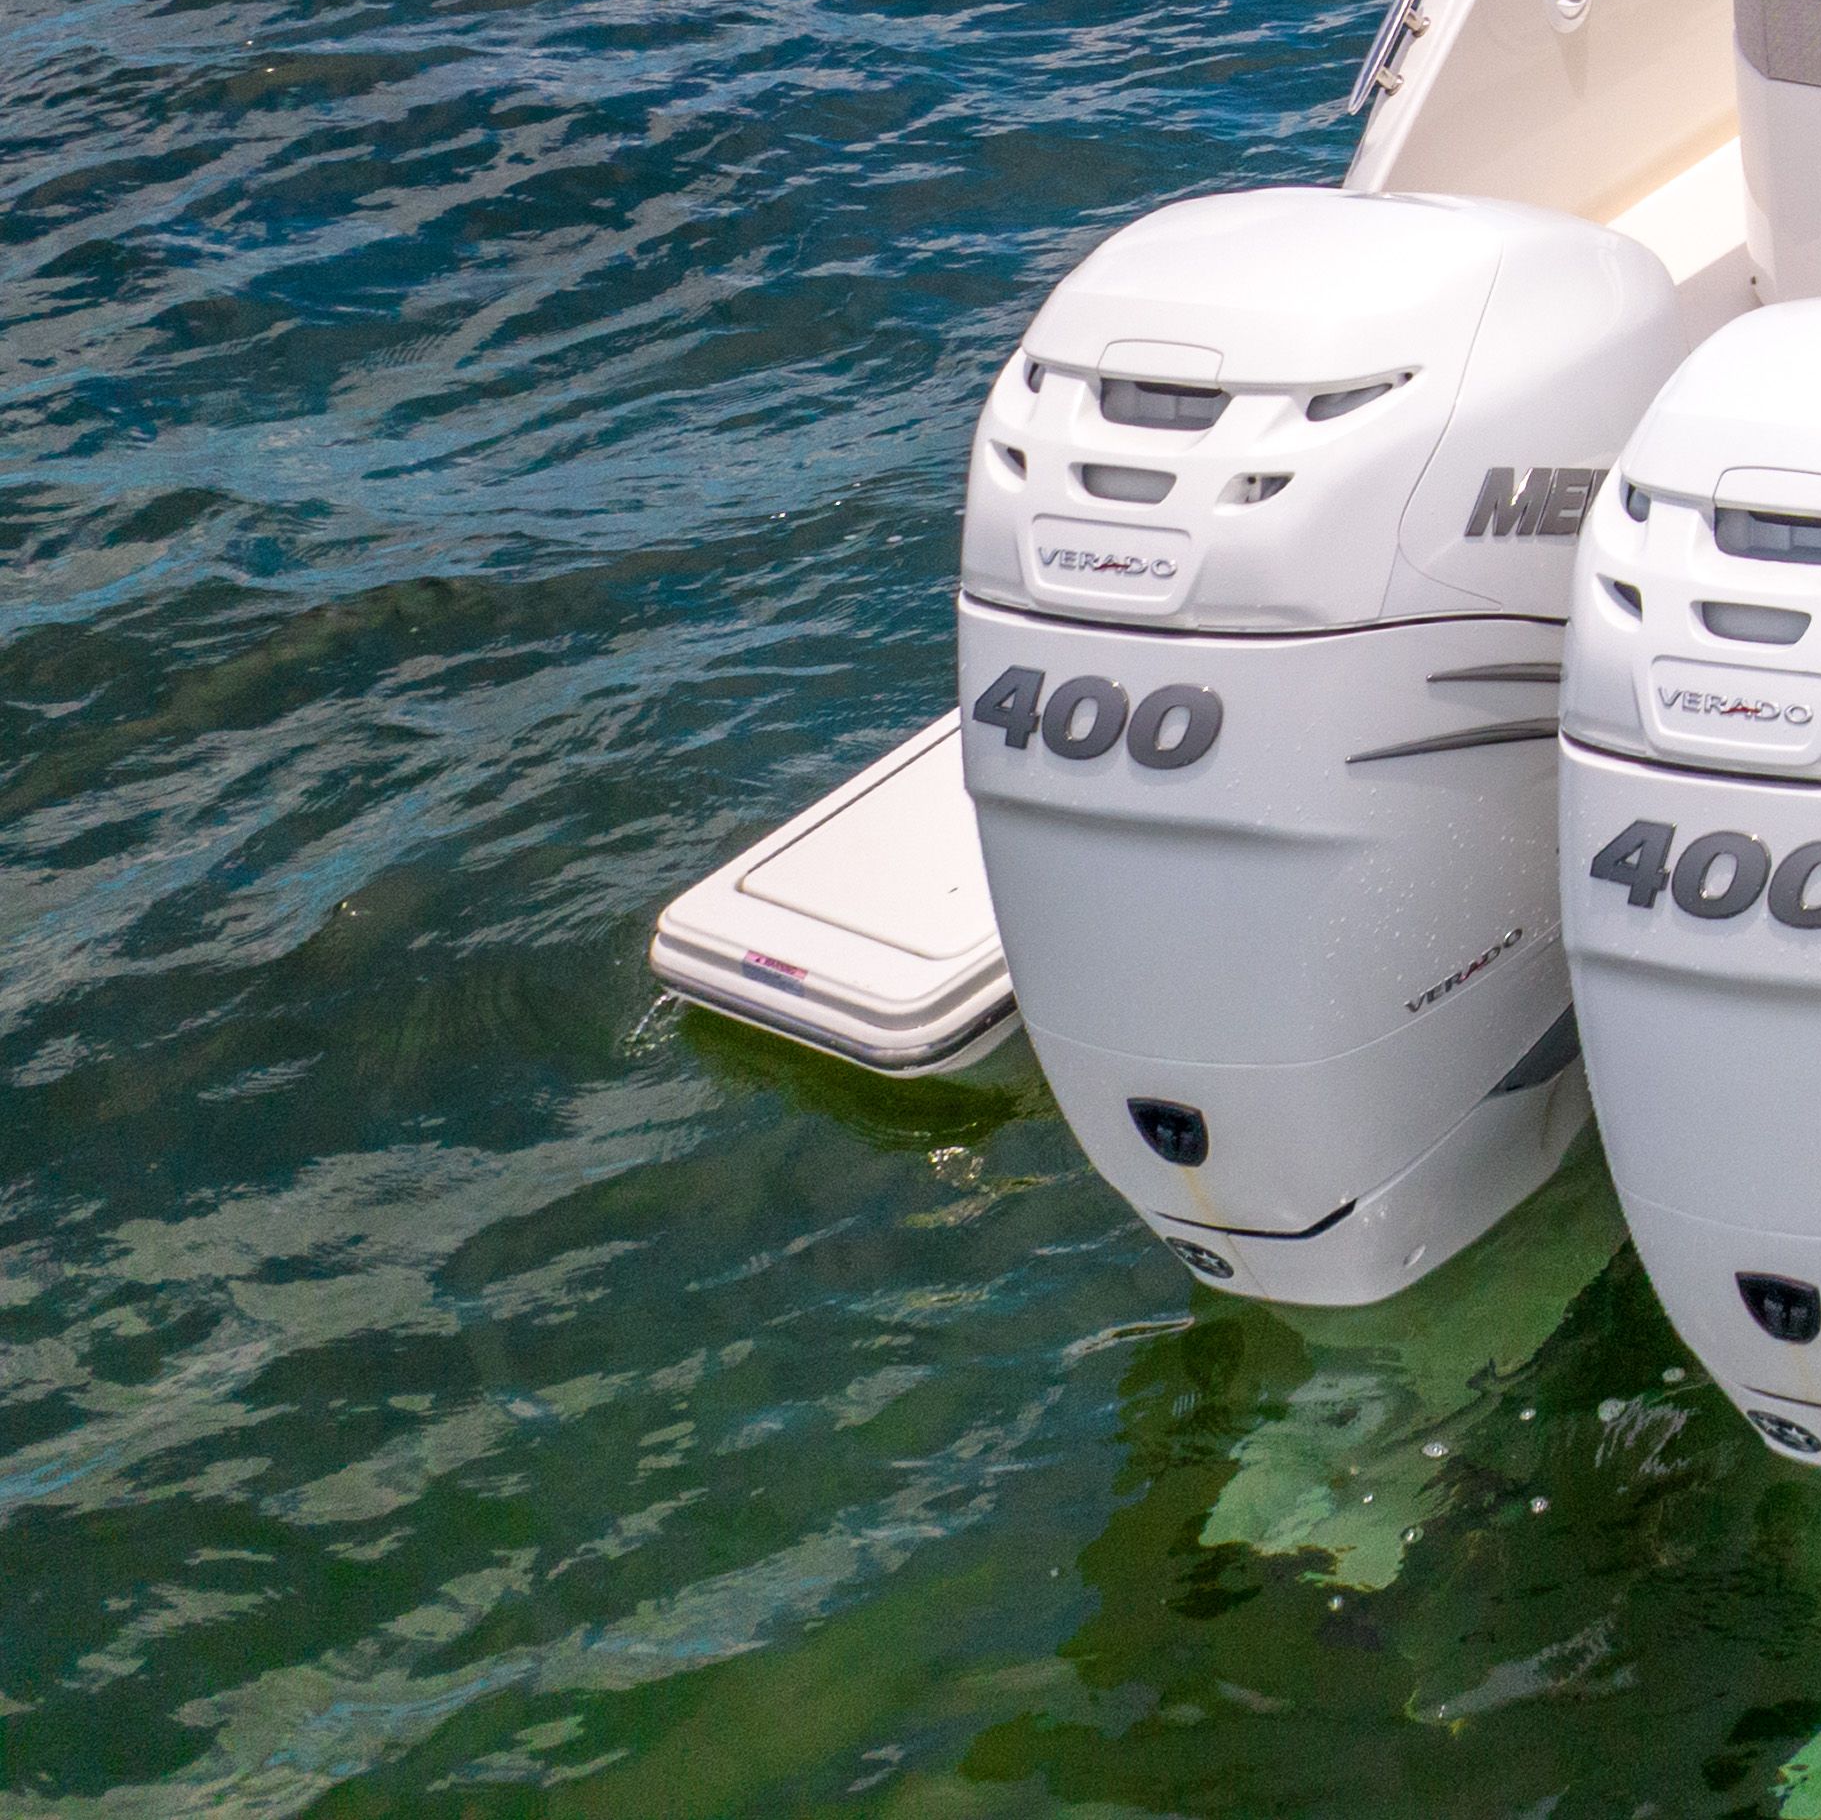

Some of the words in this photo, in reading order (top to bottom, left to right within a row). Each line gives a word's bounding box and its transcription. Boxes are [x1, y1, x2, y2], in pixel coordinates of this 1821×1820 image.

[1037, 546, 1178, 578] VERADO
[972, 664, 1225, 771] 400
[1657, 686, 1814, 725] VERADO
[1403, 928, 1523, 1013] VERADO
